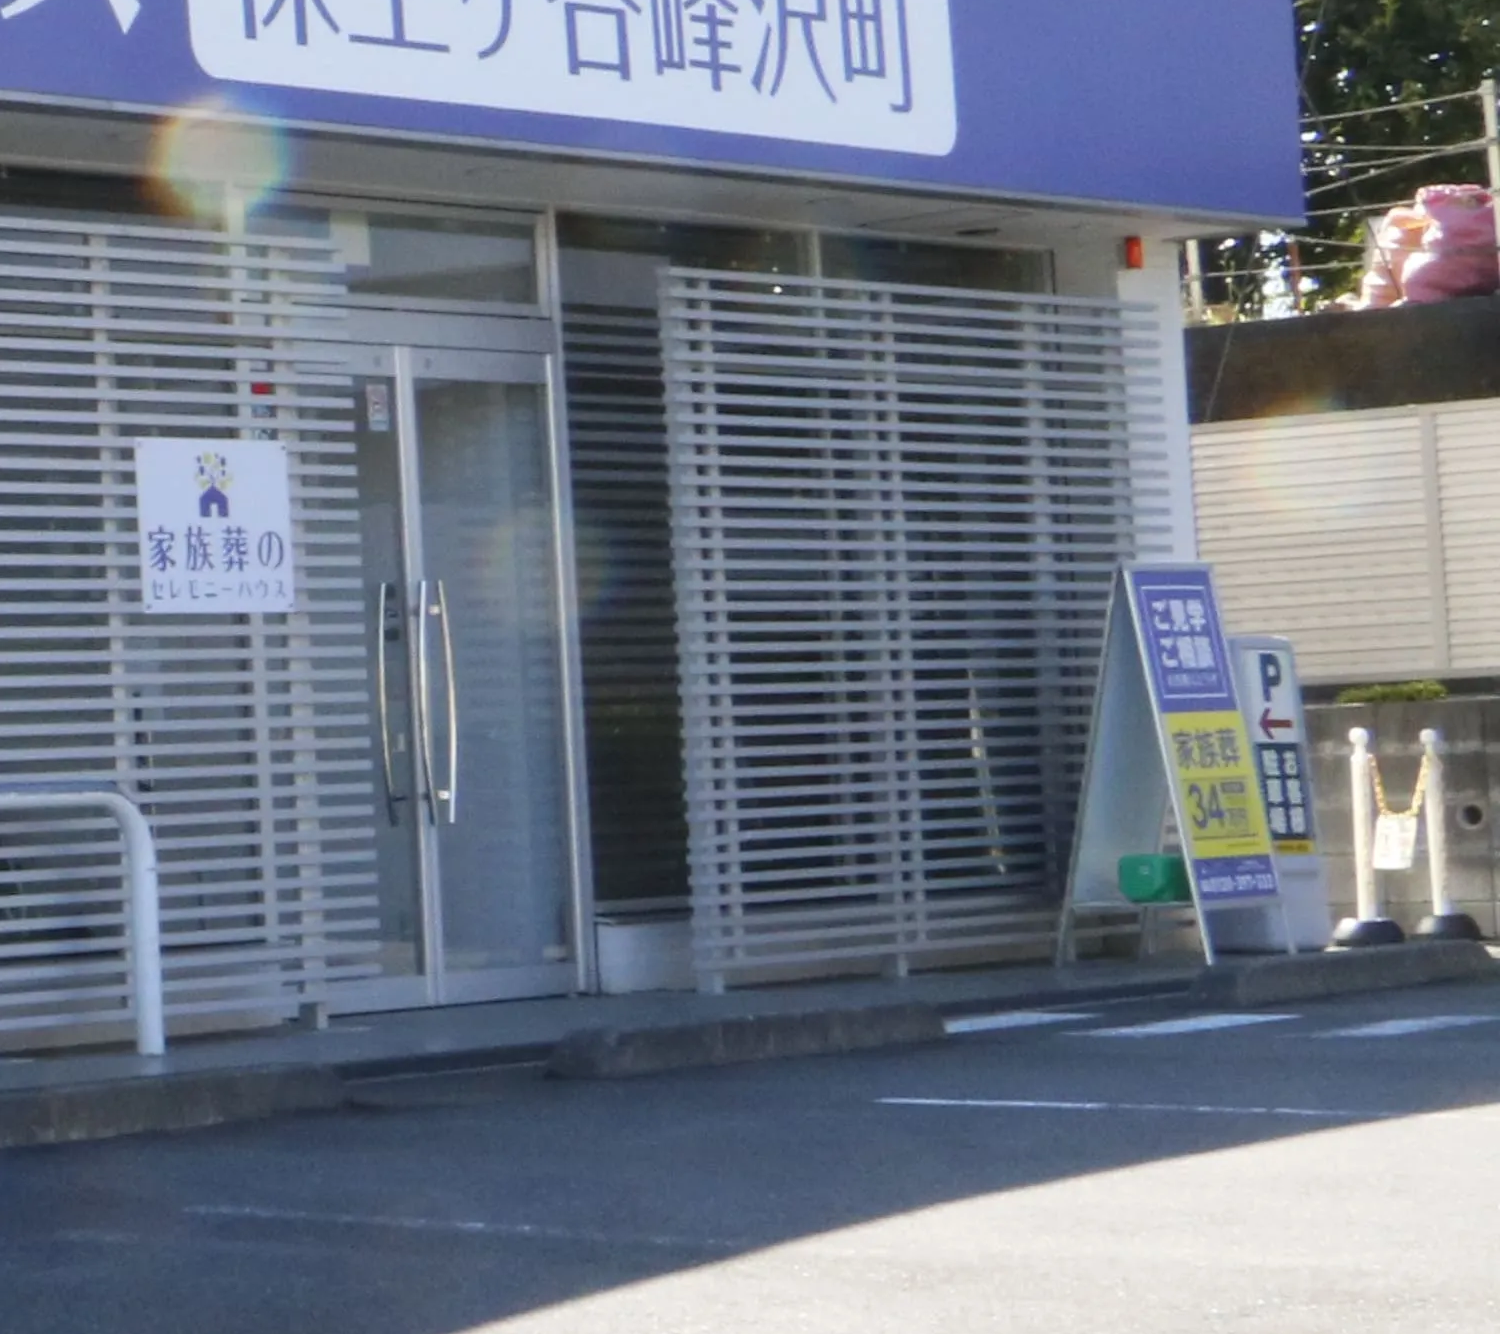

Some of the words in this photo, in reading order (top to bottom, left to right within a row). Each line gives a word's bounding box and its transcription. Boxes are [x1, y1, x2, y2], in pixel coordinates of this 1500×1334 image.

[148, 525, 285, 572] 家族葬の
[151, 578, 287, 601] セレモニーハウス
[1259, 653, 1282, 702] P
